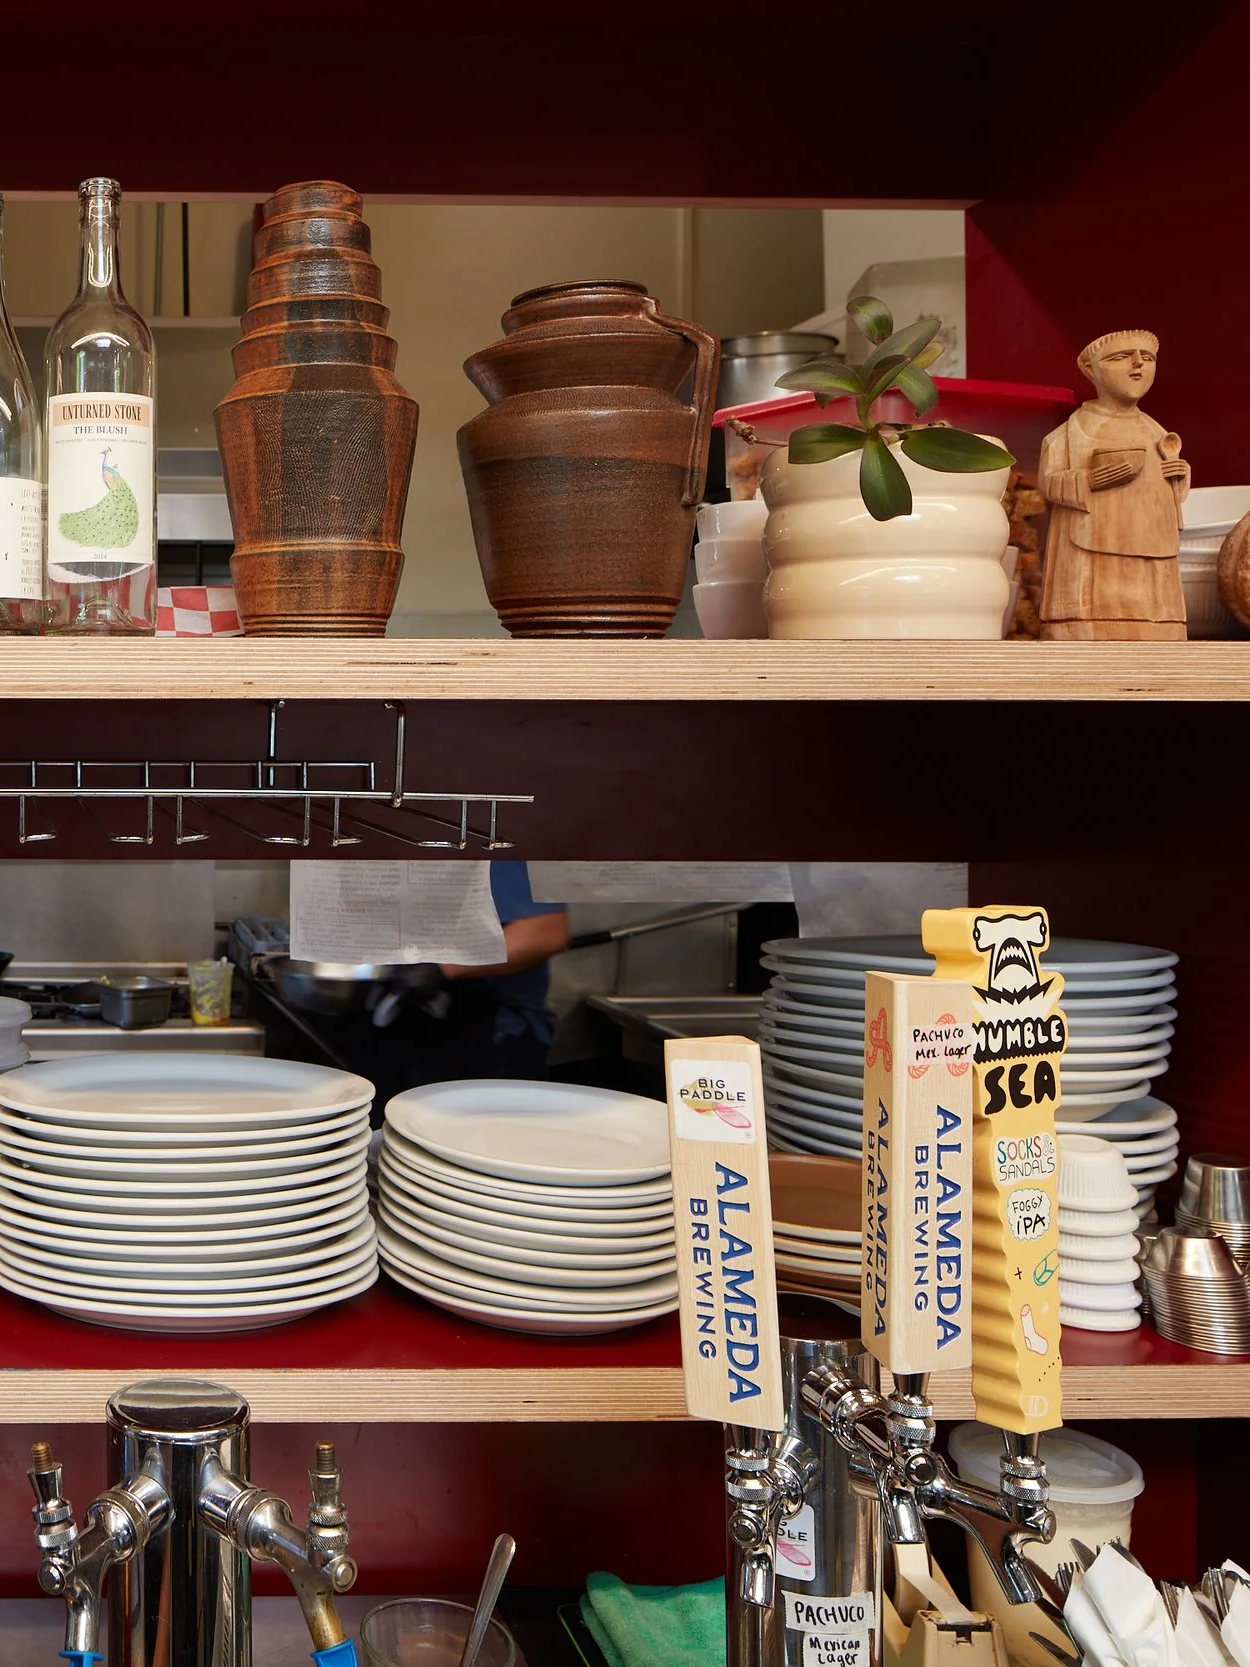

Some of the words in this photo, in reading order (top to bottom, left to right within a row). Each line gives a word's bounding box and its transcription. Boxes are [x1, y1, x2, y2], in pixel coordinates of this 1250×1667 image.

[62, 403, 111, 421] UNTURNED
[114, 403, 142, 421] STONE
[73, 425, 95, 435] THE
[96, 425, 128, 435] BLUSH
[912, 1027, 965, 1043] PACHUCO
[679, 1089, 746, 1102] PADDLE
[698, 1078, 726, 1089] BIG
[984, 1060, 1056, 1115] SEA
[997, 1135, 1042, 1165] SOCKS
[999, 1156, 1056, 1182] SANDALS
[865, 1130, 875, 1291] BREWING
[874, 1097, 890, 1337] ALAMEDA
[1012, 1195, 1043, 1214] FOGGY
[914, 1145, 930, 1312] BREWING
[936, 1104, 962, 1351] ALAMEDA
[689, 1197, 717, 1360] BREWING
[715, 1161, 762, 1403] ALAMEDA
[794, 1600, 865, 1626] PACHUCO
[809, 1636, 861, 1652] Mexican
